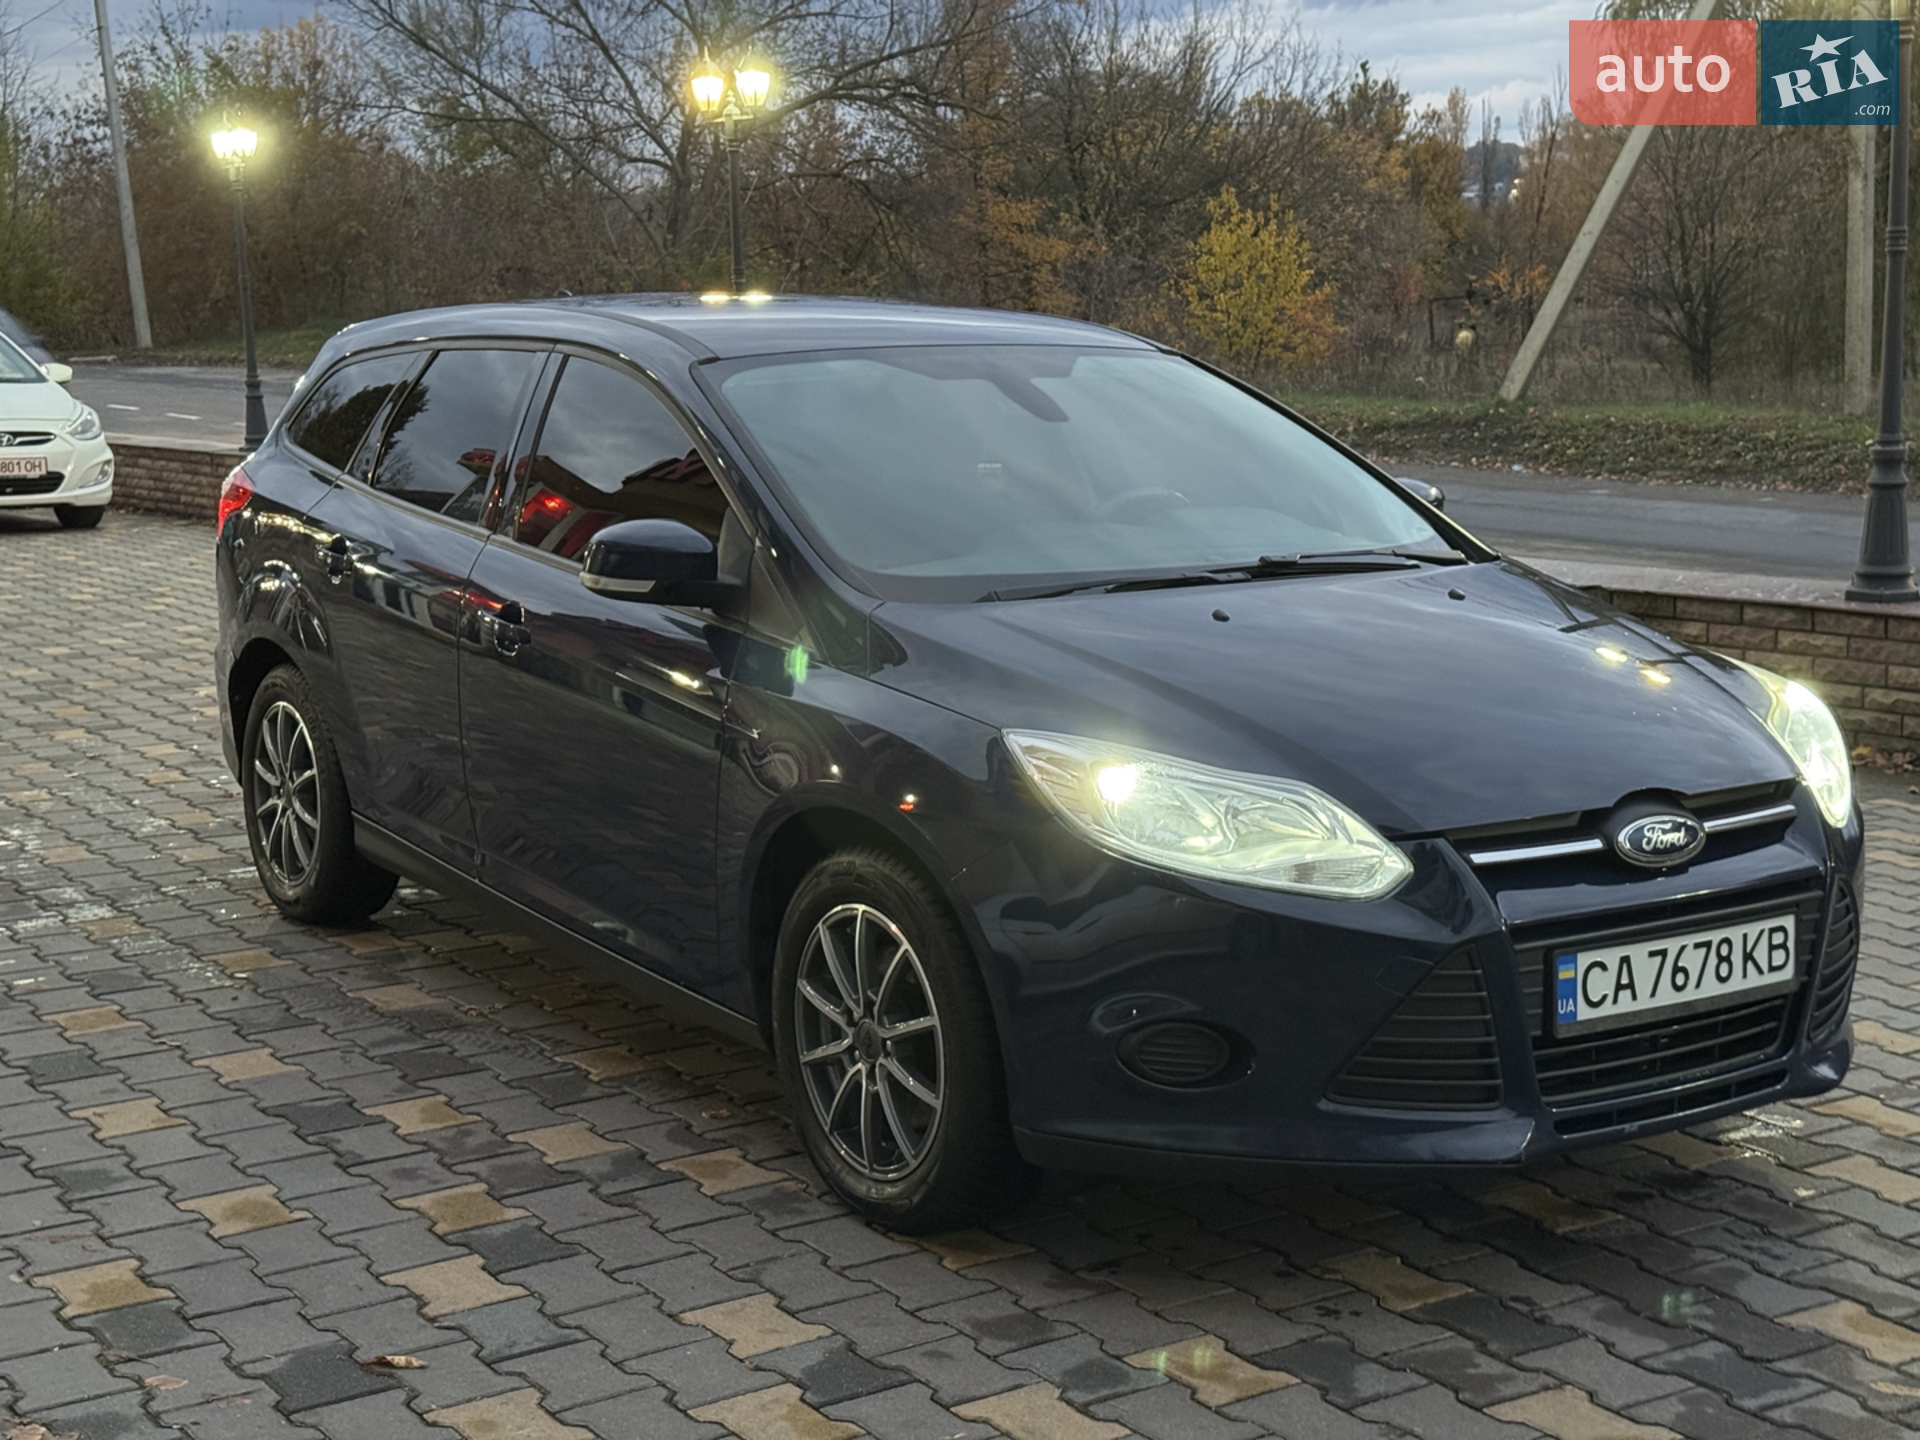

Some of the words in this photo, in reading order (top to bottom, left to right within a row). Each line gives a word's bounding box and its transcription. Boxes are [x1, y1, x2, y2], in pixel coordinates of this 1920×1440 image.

[24, 460, 42, 473] OH
[1642, 822, 1688, 851] Ford
[1581, 954, 1638, 1009] CA
[1648, 936, 1734, 999] 7678
[1741, 924, 1791, 980] KB
[1557, 998, 1576, 1015] UA
